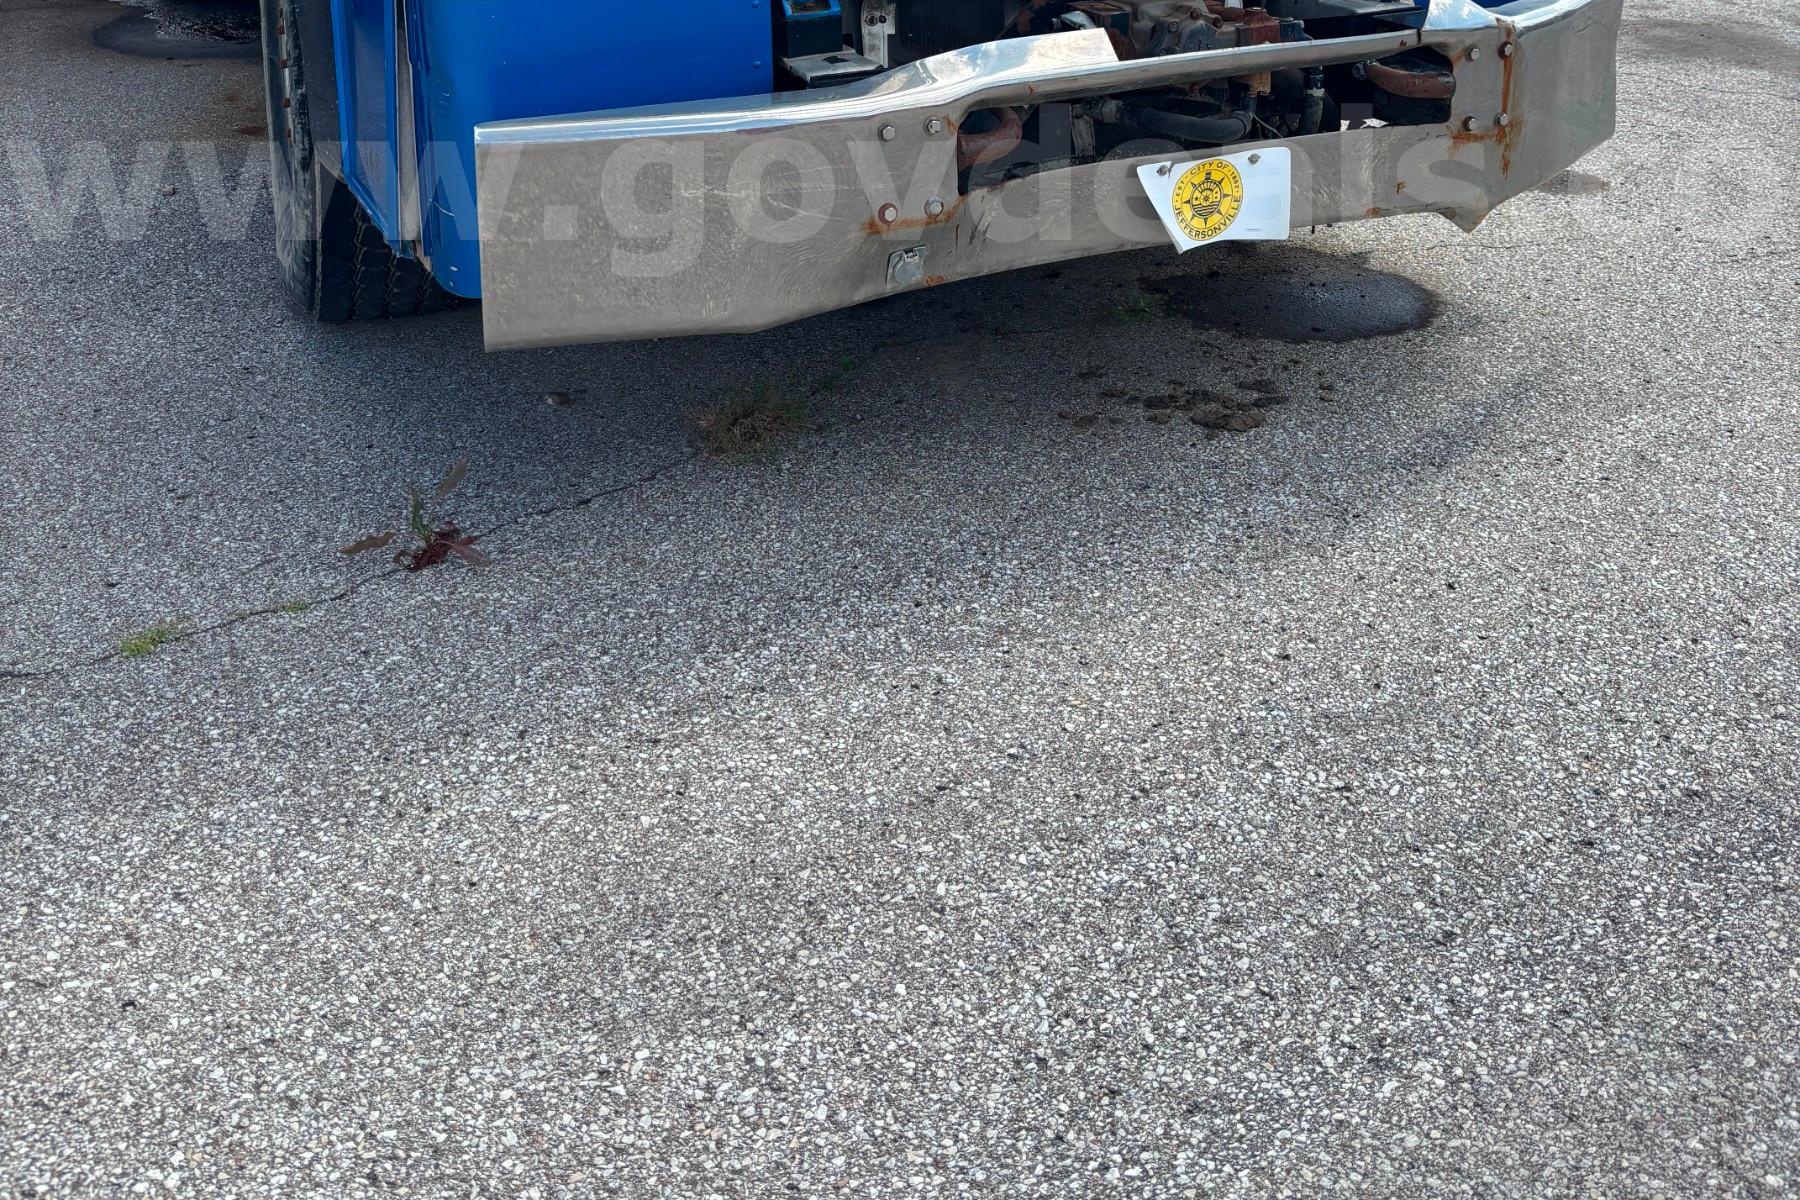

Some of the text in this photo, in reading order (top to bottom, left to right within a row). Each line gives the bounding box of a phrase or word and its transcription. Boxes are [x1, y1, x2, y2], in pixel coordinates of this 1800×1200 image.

[1190, 160, 1230, 175] CITY OF
[1175, 180, 1185, 197] EST
[1174, 195, 1241, 239] JEFFERSONVILLE
